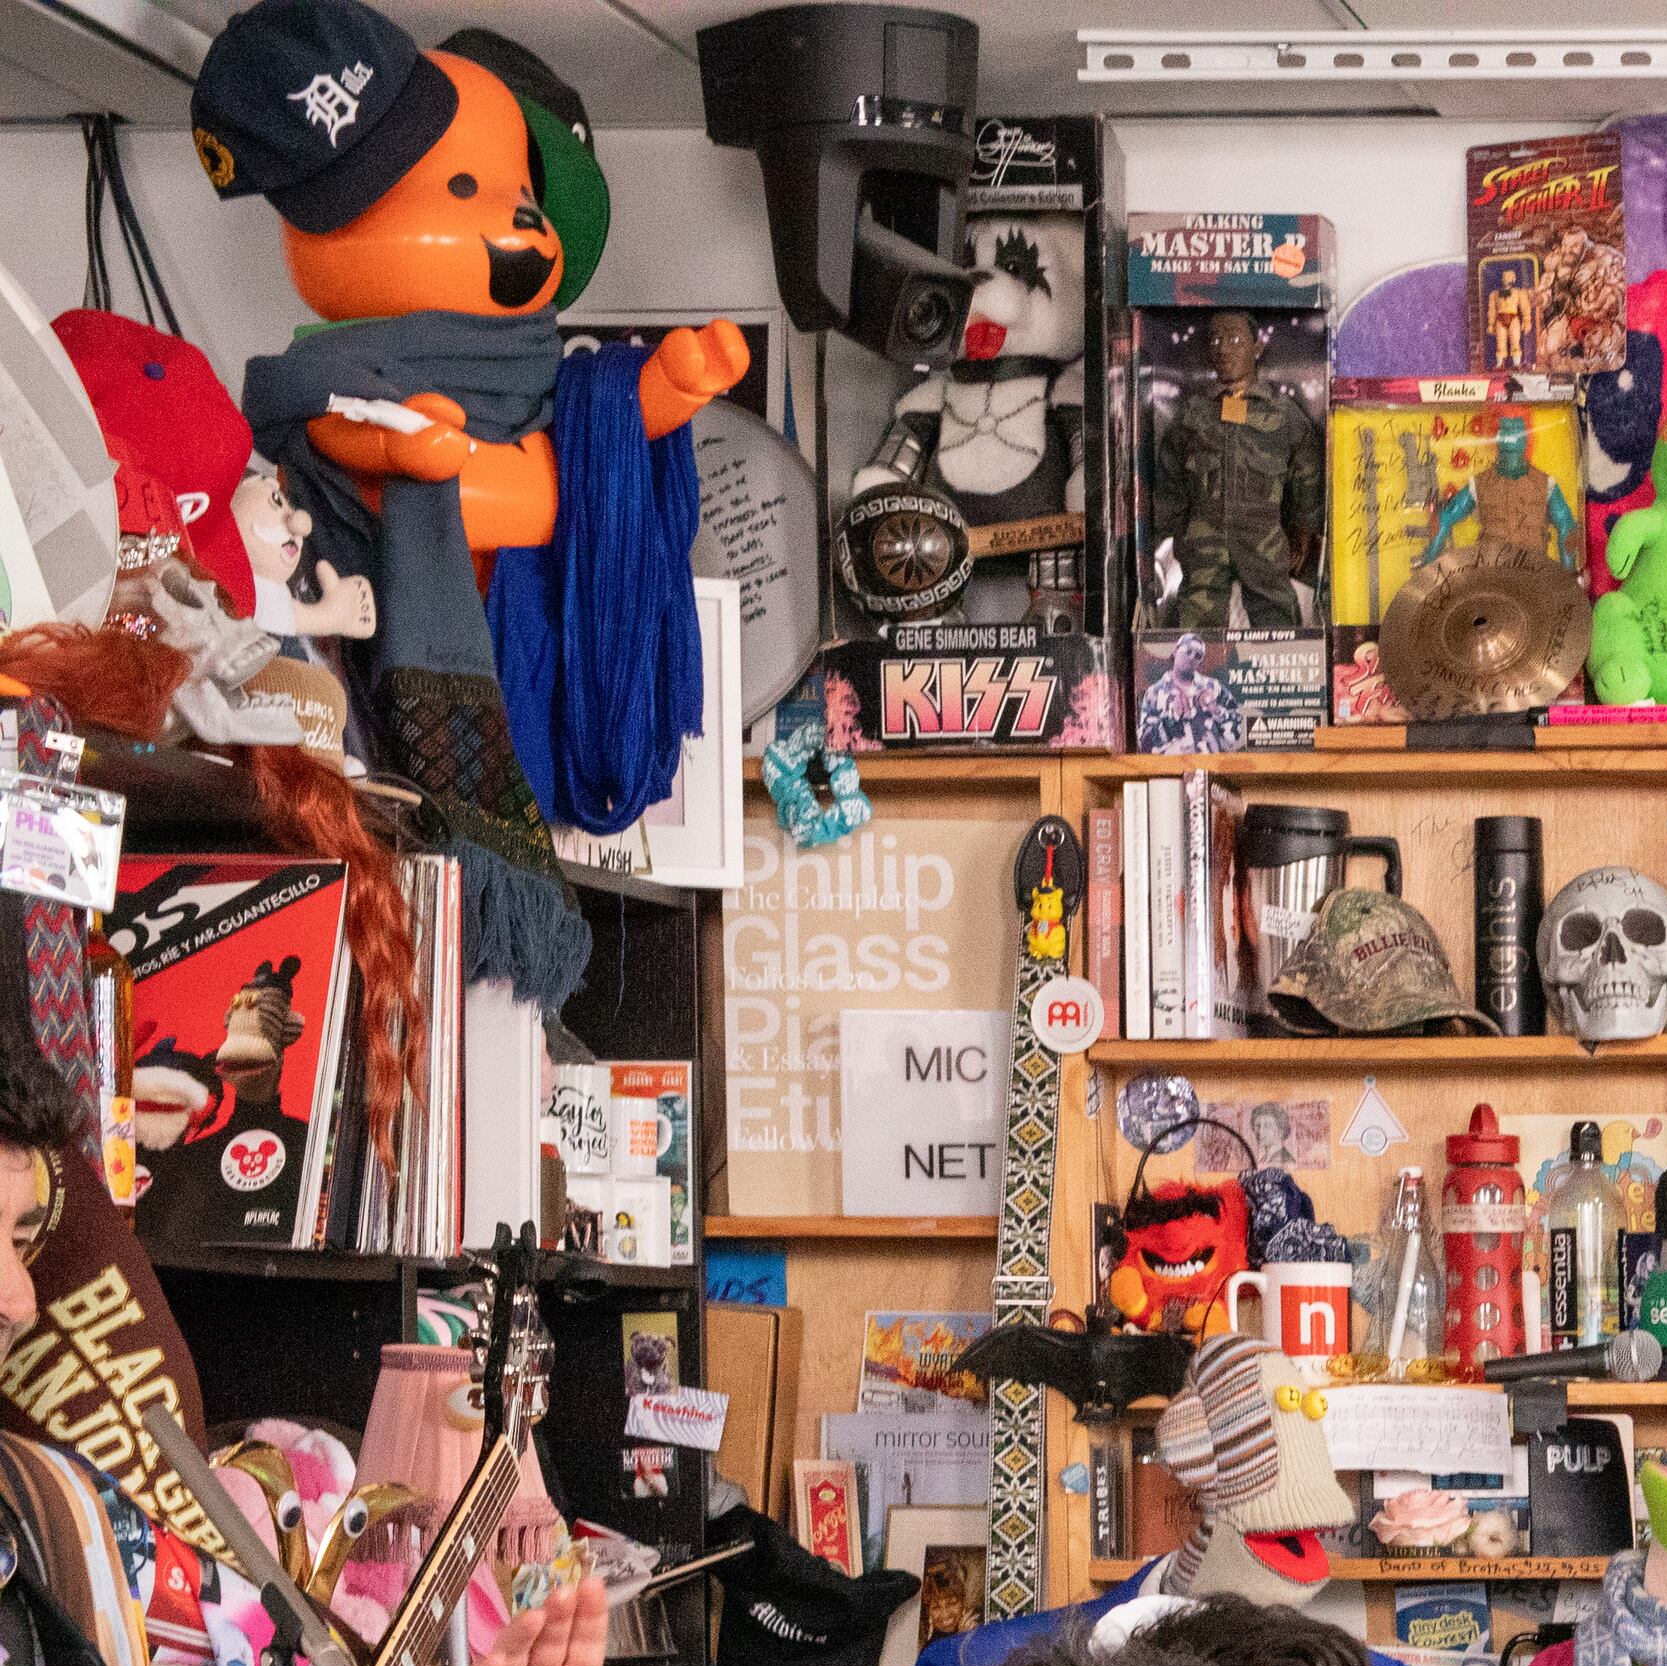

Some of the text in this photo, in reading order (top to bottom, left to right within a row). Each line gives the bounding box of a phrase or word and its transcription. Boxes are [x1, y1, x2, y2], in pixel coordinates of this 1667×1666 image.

[1474, 156, 1558, 206] STREET
[1501, 175, 1582, 224] FIGHTER
[1185, 214, 1264, 230] TALKING
[1141, 232, 1274, 257] MASTER
[1151, 260, 1192, 274] MAKE
[1224, 260, 1251, 273] SAY
[1432, 382, 1478, 400] Blanka
[896, 627, 1036, 647] GENE SIMMONS BEAR
[1228, 668, 1321, 684] MASTER P
[1248, 653, 1320, 668] TALKING
[881, 656, 1060, 740] KISS
[598, 843, 632, 875] WISH
[741, 831, 956, 930] Philip
[724, 914, 952, 993] Glass
[1354, 932, 1409, 963] BILLIE
[904, 1045, 988, 1083] MIC
[903, 1142, 996, 1179] NET
[1300, 1301, 1336, 1346] n
[874, 1428, 939, 1449] mirror
[1546, 1443, 1612, 1474] PULP
[1095, 1465, 1111, 1541] TRIBES
[1440, 1612, 1471, 1629] desk
